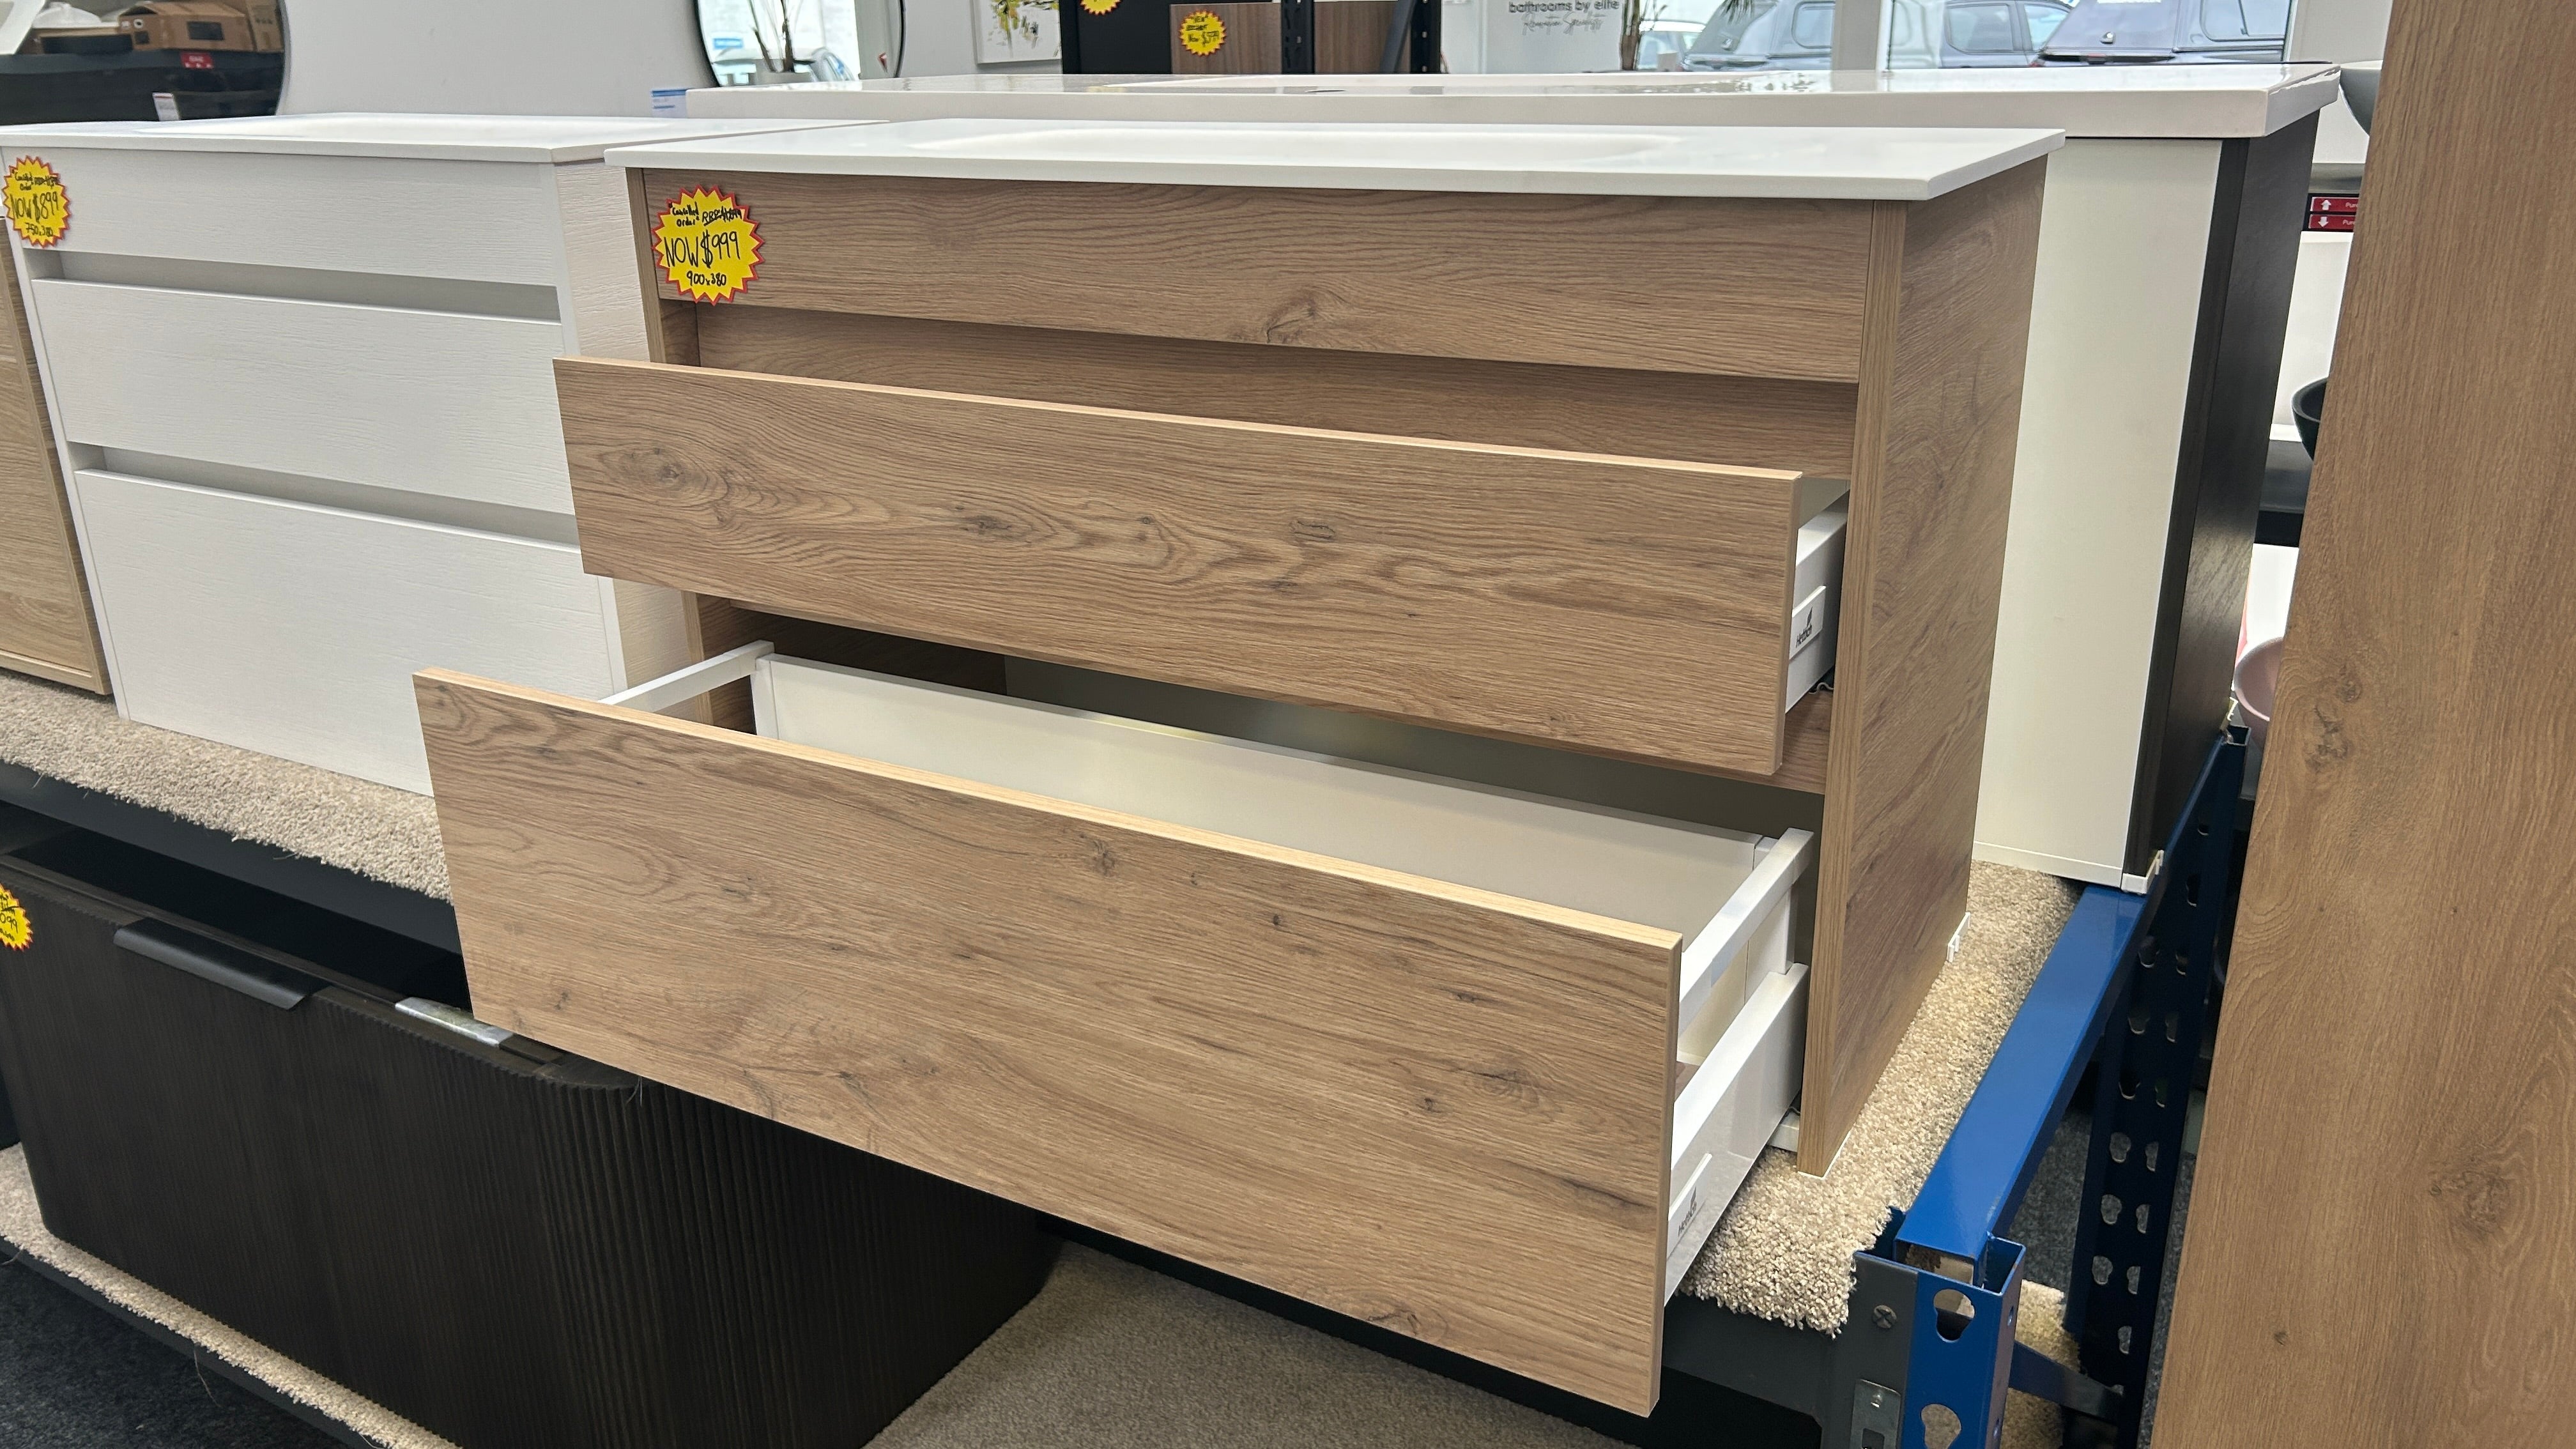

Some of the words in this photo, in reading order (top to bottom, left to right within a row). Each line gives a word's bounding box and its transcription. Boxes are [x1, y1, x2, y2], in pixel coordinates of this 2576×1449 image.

[1508, 1, 1573, 13] bathrooms
[1574, 0, 1591, 13] by
[1593, 0, 1620, 10] elite
[663, 236, 699, 268] NOW
[700, 229, 740, 269] $999
